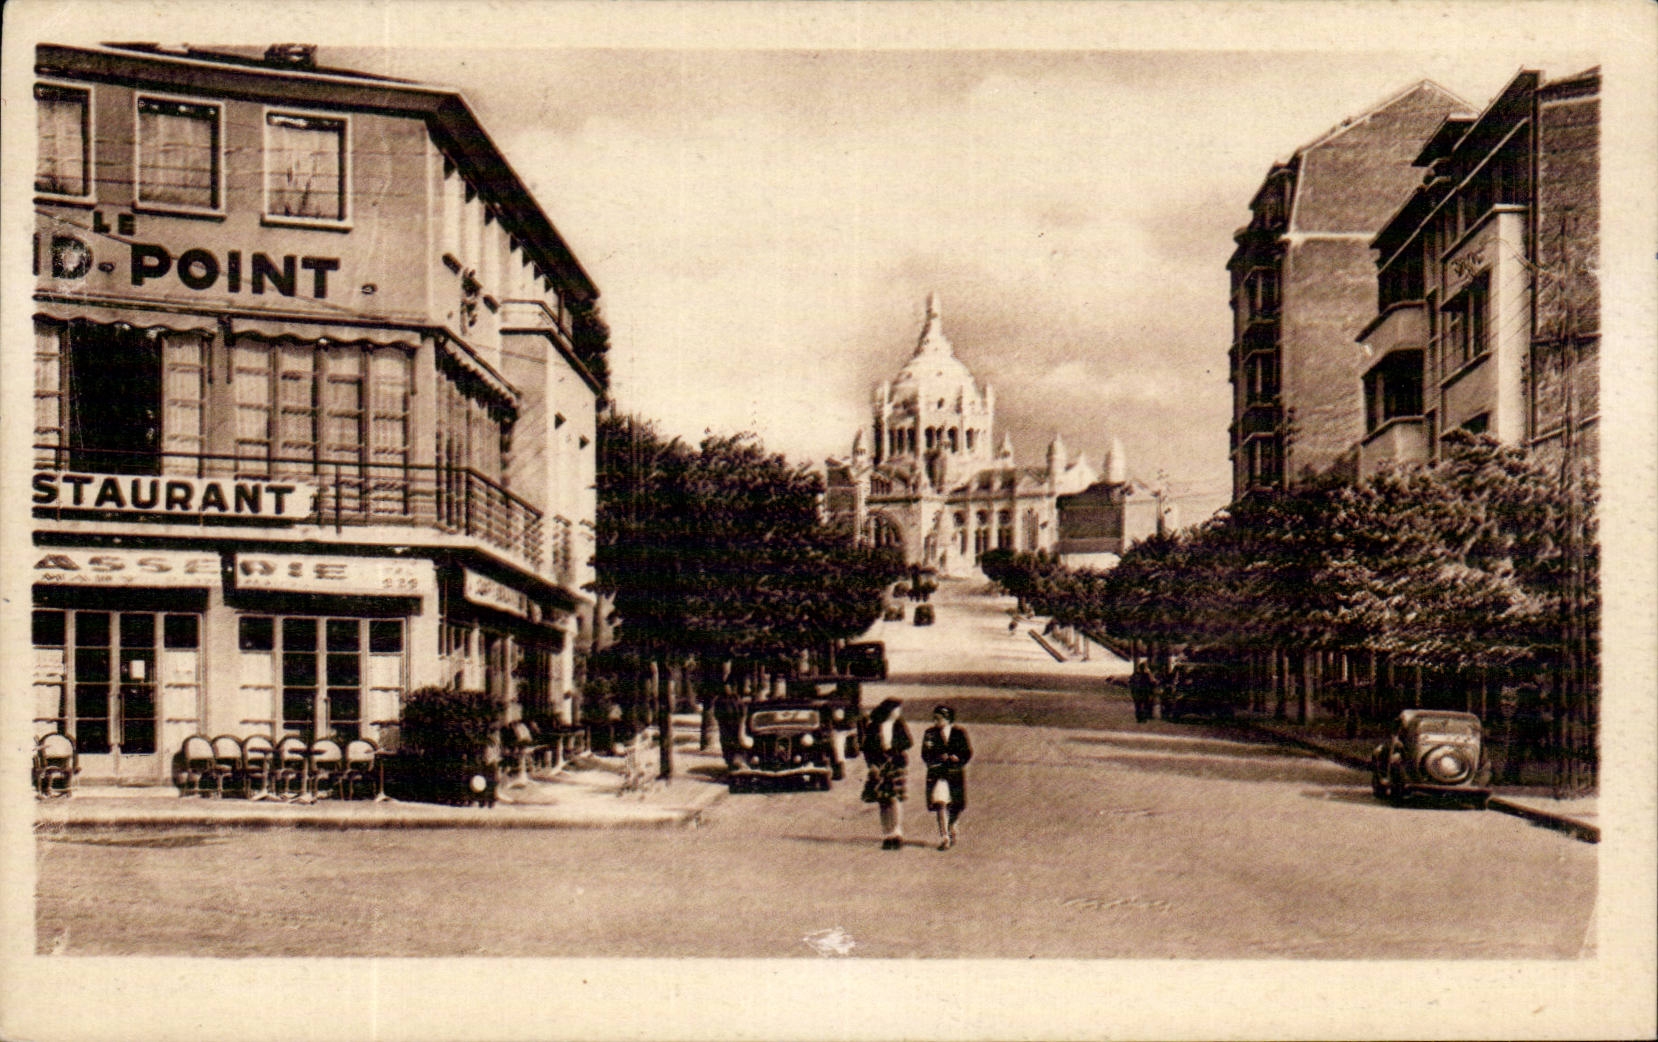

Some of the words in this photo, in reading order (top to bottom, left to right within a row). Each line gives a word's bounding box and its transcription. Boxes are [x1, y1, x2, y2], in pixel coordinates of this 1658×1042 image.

[93, 211, 135, 235] LE
[131, 243, 340, 298] POINT
[32, 473, 296, 515] STAURANT
